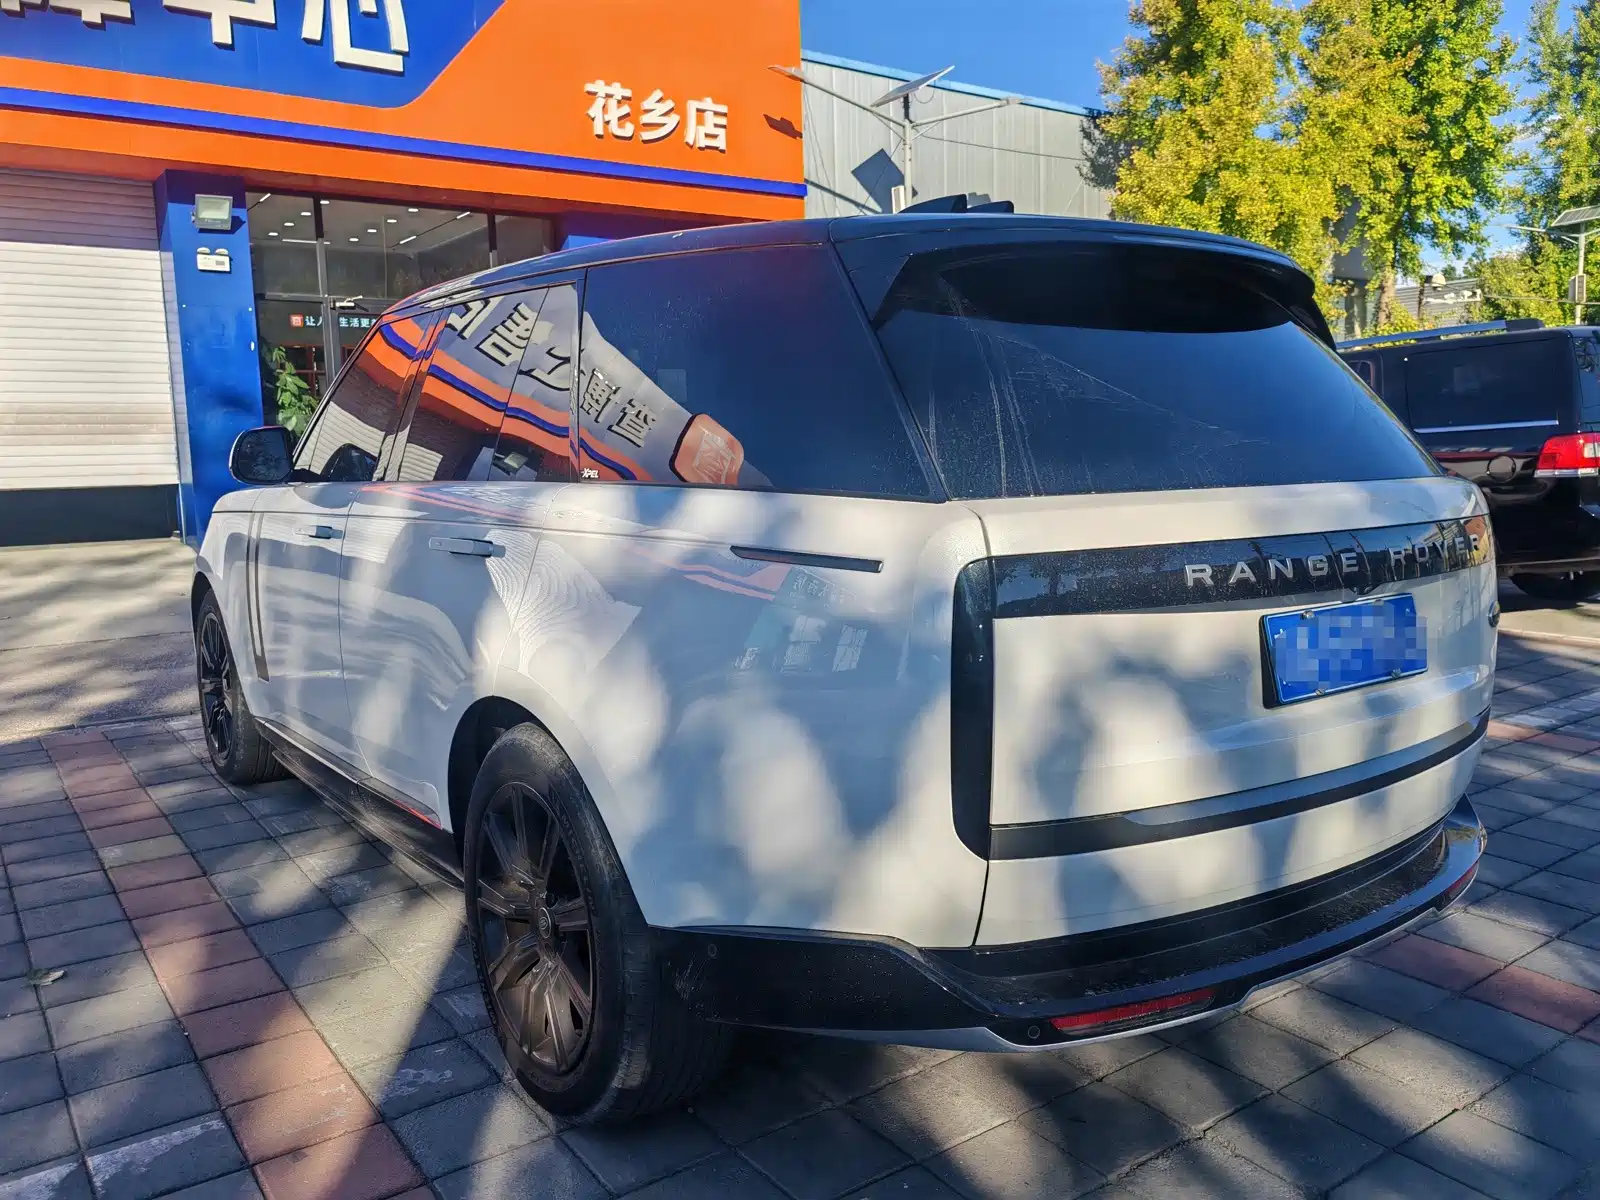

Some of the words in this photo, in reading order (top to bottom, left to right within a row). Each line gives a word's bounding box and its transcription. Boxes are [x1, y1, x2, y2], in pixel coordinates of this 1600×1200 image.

[584, 80, 728, 152] 花乡店
[581, 467, 599, 478] XPEL
[1185, 552, 1359, 587] RANGE
[1390, 533, 1480, 565] ROVER
